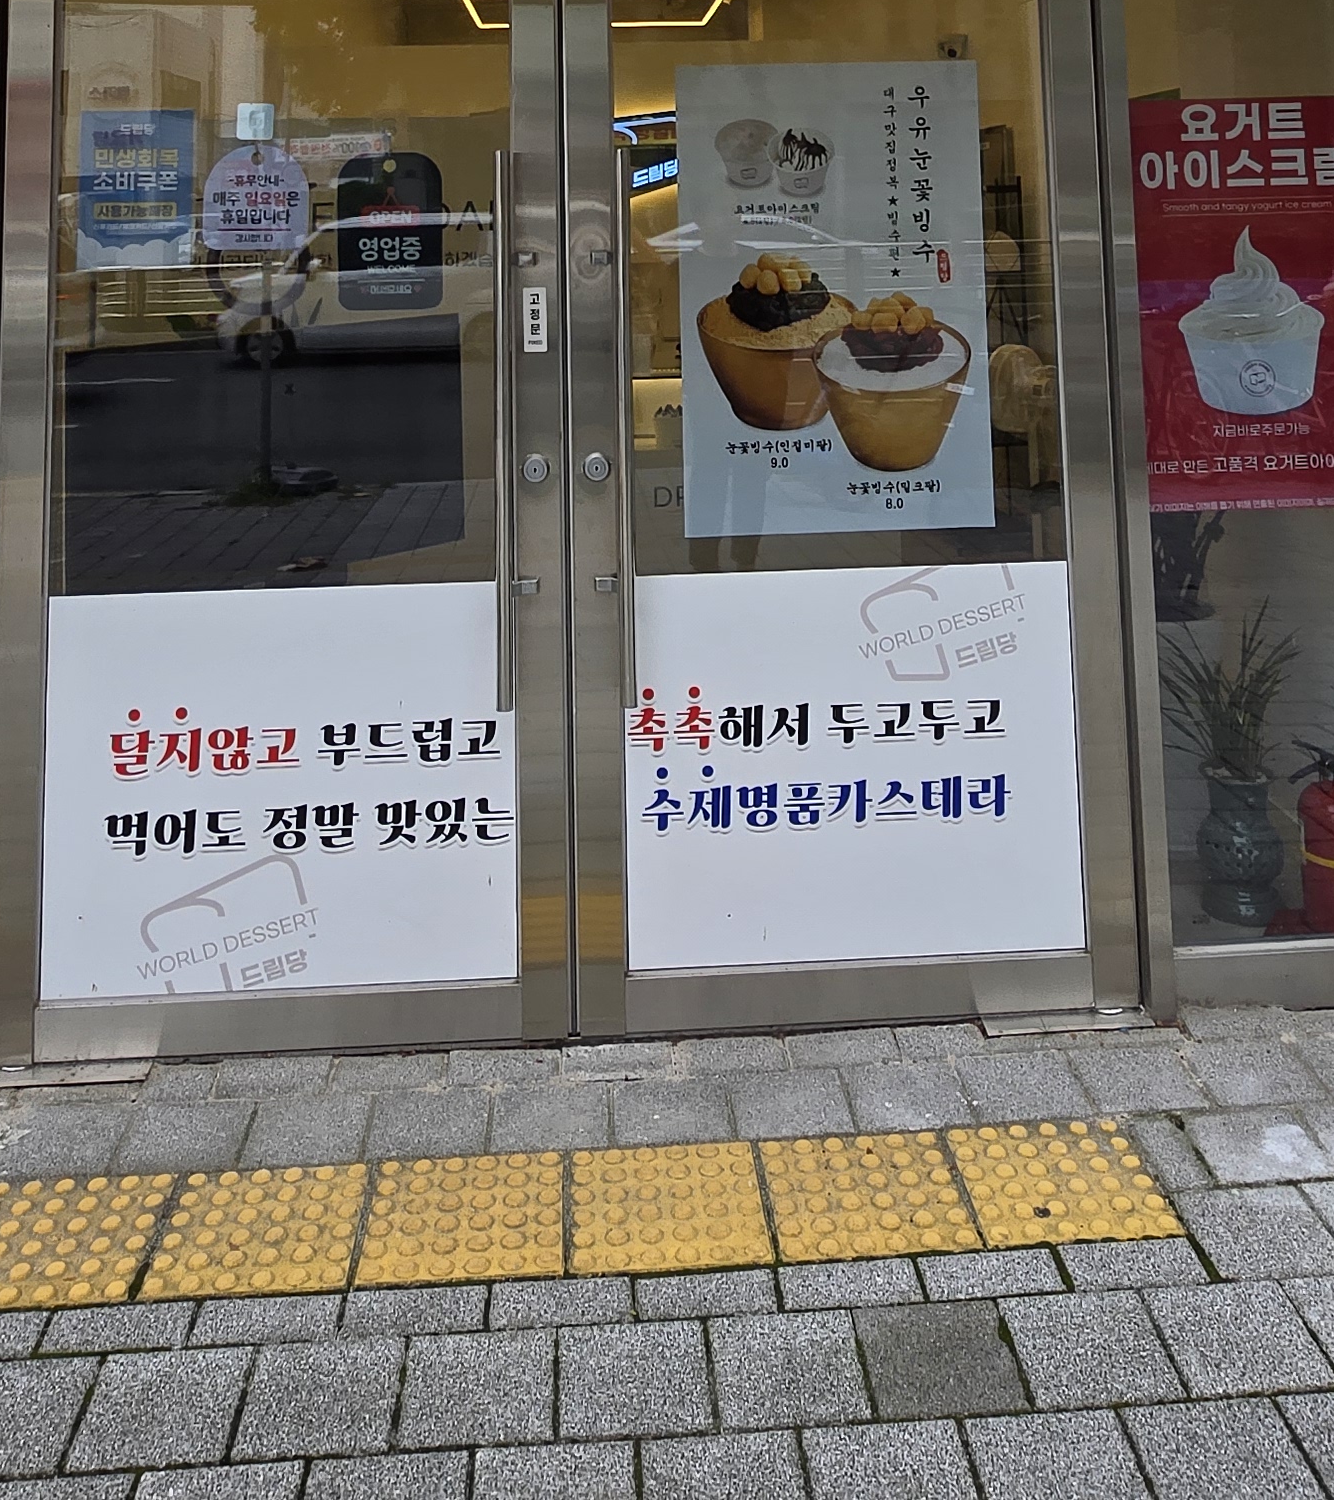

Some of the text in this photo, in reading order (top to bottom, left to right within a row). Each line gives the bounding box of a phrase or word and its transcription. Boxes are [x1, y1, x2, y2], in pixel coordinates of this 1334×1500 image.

[1180, 102, 1306, 142] 요거트
[94, 148, 179, 168] 민생회복
[93, 171, 179, 191] 소비쿠폰
[907, 86, 935, 263] 우유눈꽃빙수
[213, 191, 300, 207] 매주 일요일은
[1162, 200, 1333, 213] Smooth and tangy yogurt ice cream
[220, 209, 291, 224] 휴일입니다
[359, 237, 422, 261] 영업중
[367, 264, 416, 274] WELCOME
[530, 293, 541, 336] 고정문
[1213, 422, 1311, 438] 지금바로주문가능
[770, 457, 789, 468] 9.0
[1213, 456, 1259, 473] 고품격
[885, 498, 904, 509] 8.0
[858, 594, 1026, 660] WORLD DESSERT
[955, 632, 1018, 669] 드림당
[627, 699, 1006, 752] 촉촉해서 두고두고
[110, 718, 502, 777] 달지않고 부드럽고
[641, 772, 1013, 833] 수제명품카스테라
[105, 797, 514, 856] 먹어도 정말 맛있는
[136, 907, 319, 981] WORLD DESSERT
[240, 948, 309, 989] 드림당
